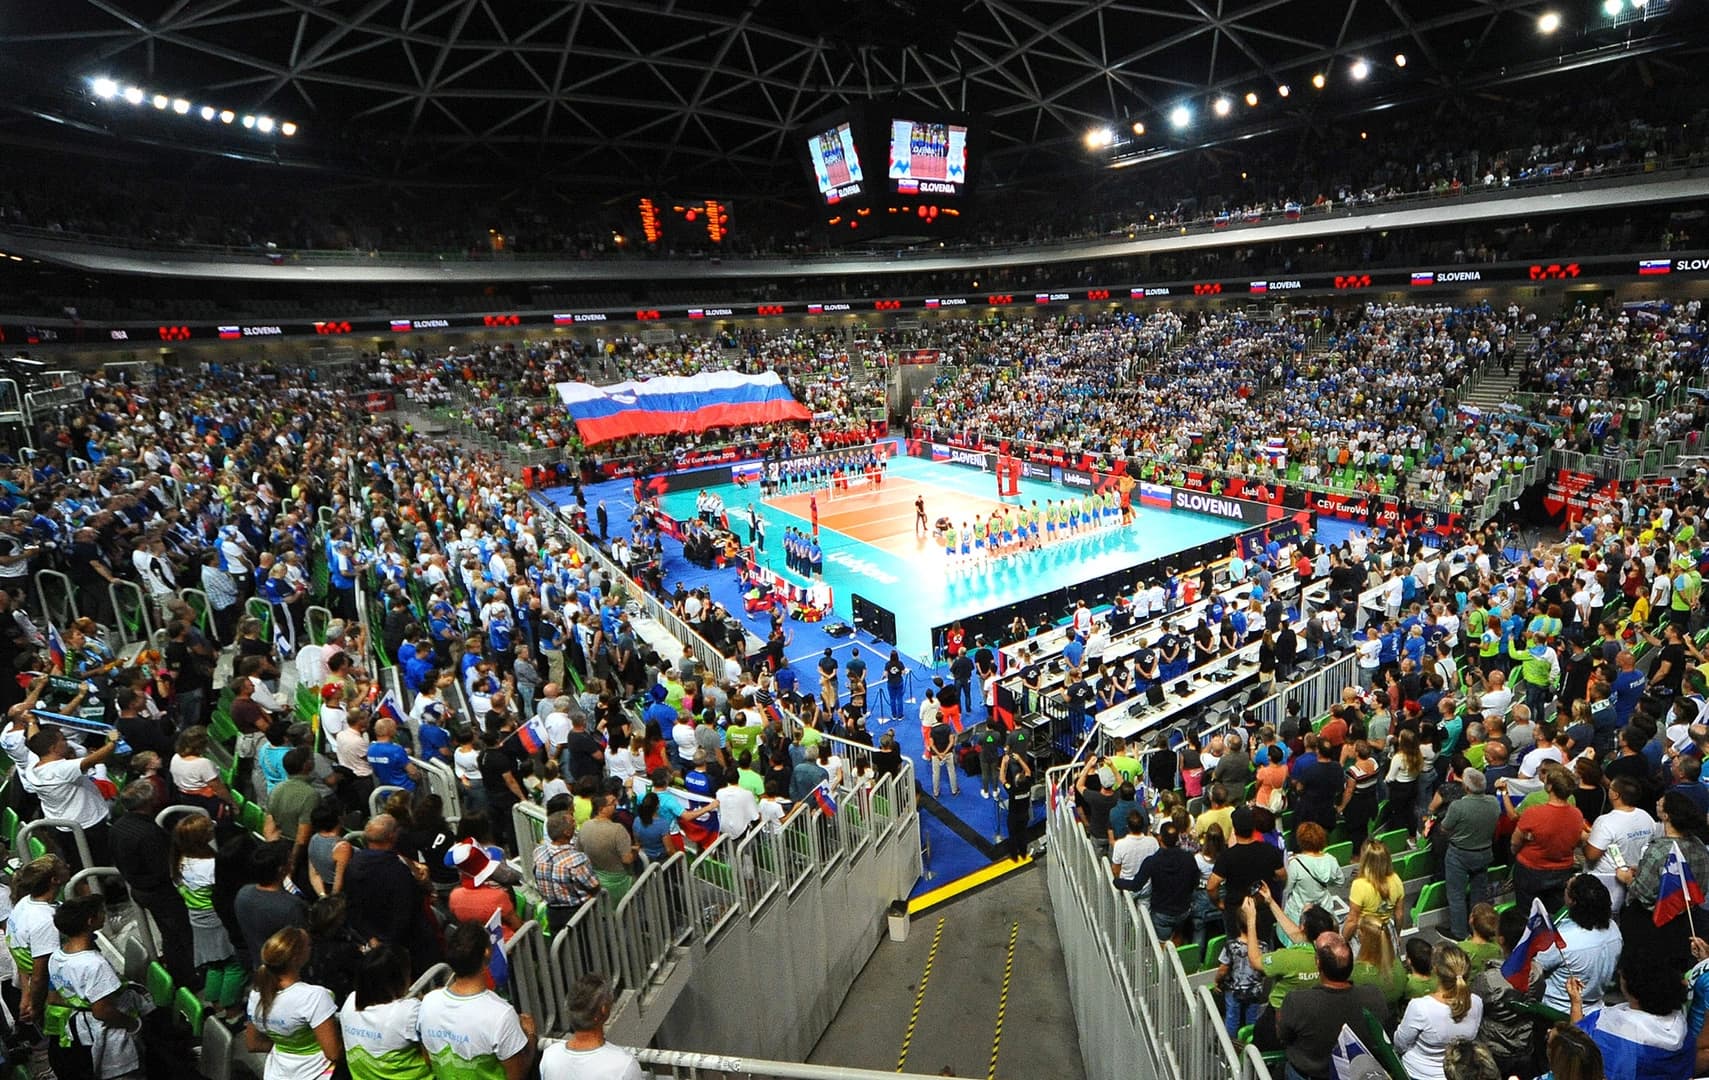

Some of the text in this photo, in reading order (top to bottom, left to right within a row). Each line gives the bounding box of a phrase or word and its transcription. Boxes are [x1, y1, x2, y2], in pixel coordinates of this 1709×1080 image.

[838, 185, 861, 197] SLOVENIA
[920, 183, 955, 193] SLOVENIA
[1676, 260, 1709, 271] SLOV
[1436, 271, 1481, 282] SLOVENIA
[1269, 281, 1301, 290] SLOVENIA
[705, 308, 732, 316] SLOVENIA
[824, 303, 850, 311] SLOVENIA
[574, 314, 607, 322] SLOVENIA
[413, 319, 449, 329] SLOVENIA
[243, 326, 282, 336] SLOVENIA
[1242, 486, 1275, 499] Ljubla
[1176, 492, 1243, 519] SLOVENIA
[1317, 500, 1335, 510] CEV
[1336, 503, 1382, 520] EuroVoly
